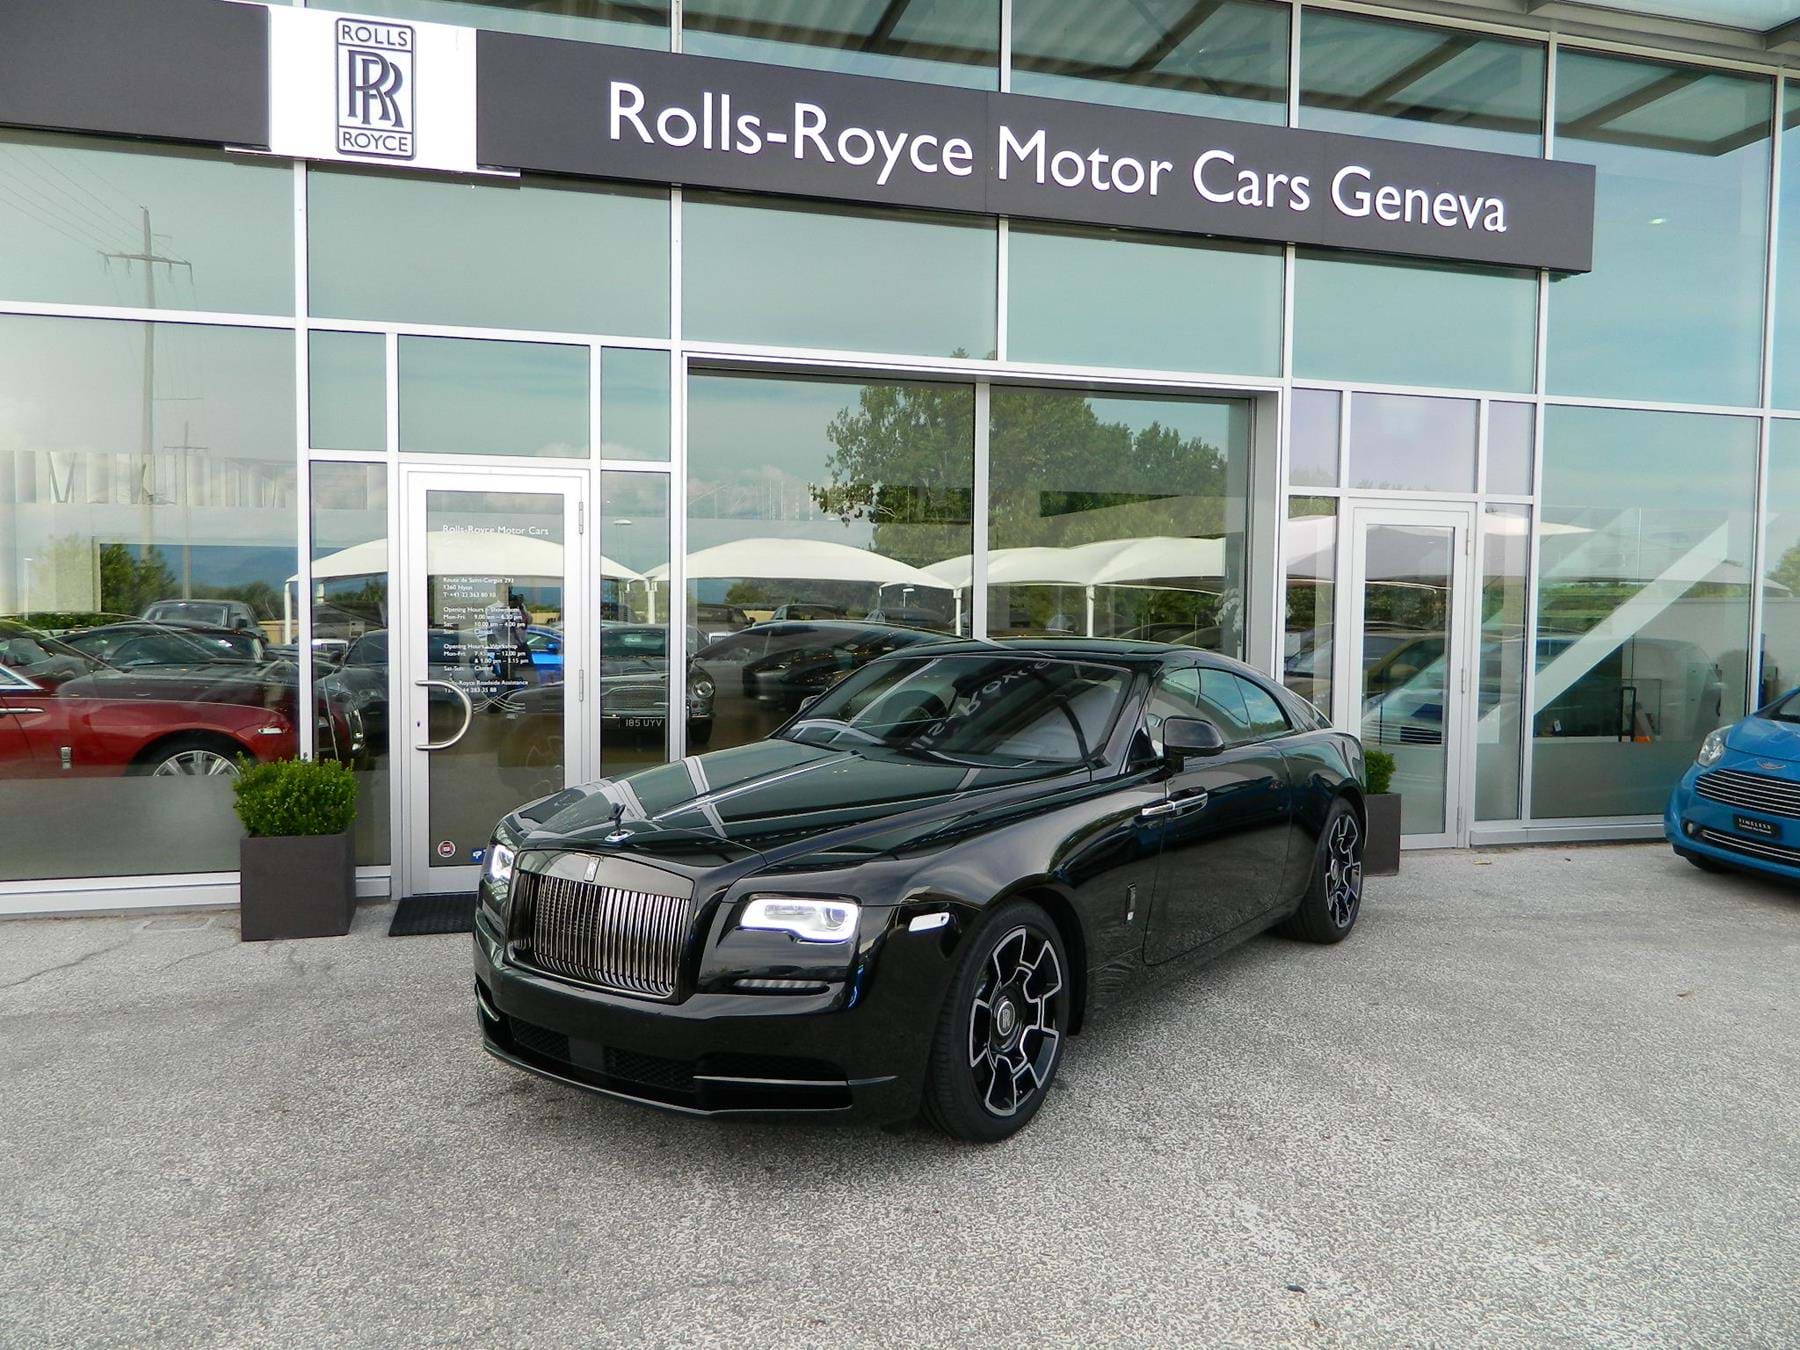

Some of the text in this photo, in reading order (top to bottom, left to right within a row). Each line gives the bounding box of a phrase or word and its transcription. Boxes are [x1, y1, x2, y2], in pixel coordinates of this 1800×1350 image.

[342, 24, 408, 47] ROLLS
[342, 131, 408, 152] ROYCE
[608, 80, 1509, 234] Rolls-Royce Motor Cars Geneva
[442, 524, 549, 535] Rolls-Royce Motor Cars
[643, 719, 663, 727] UYV
